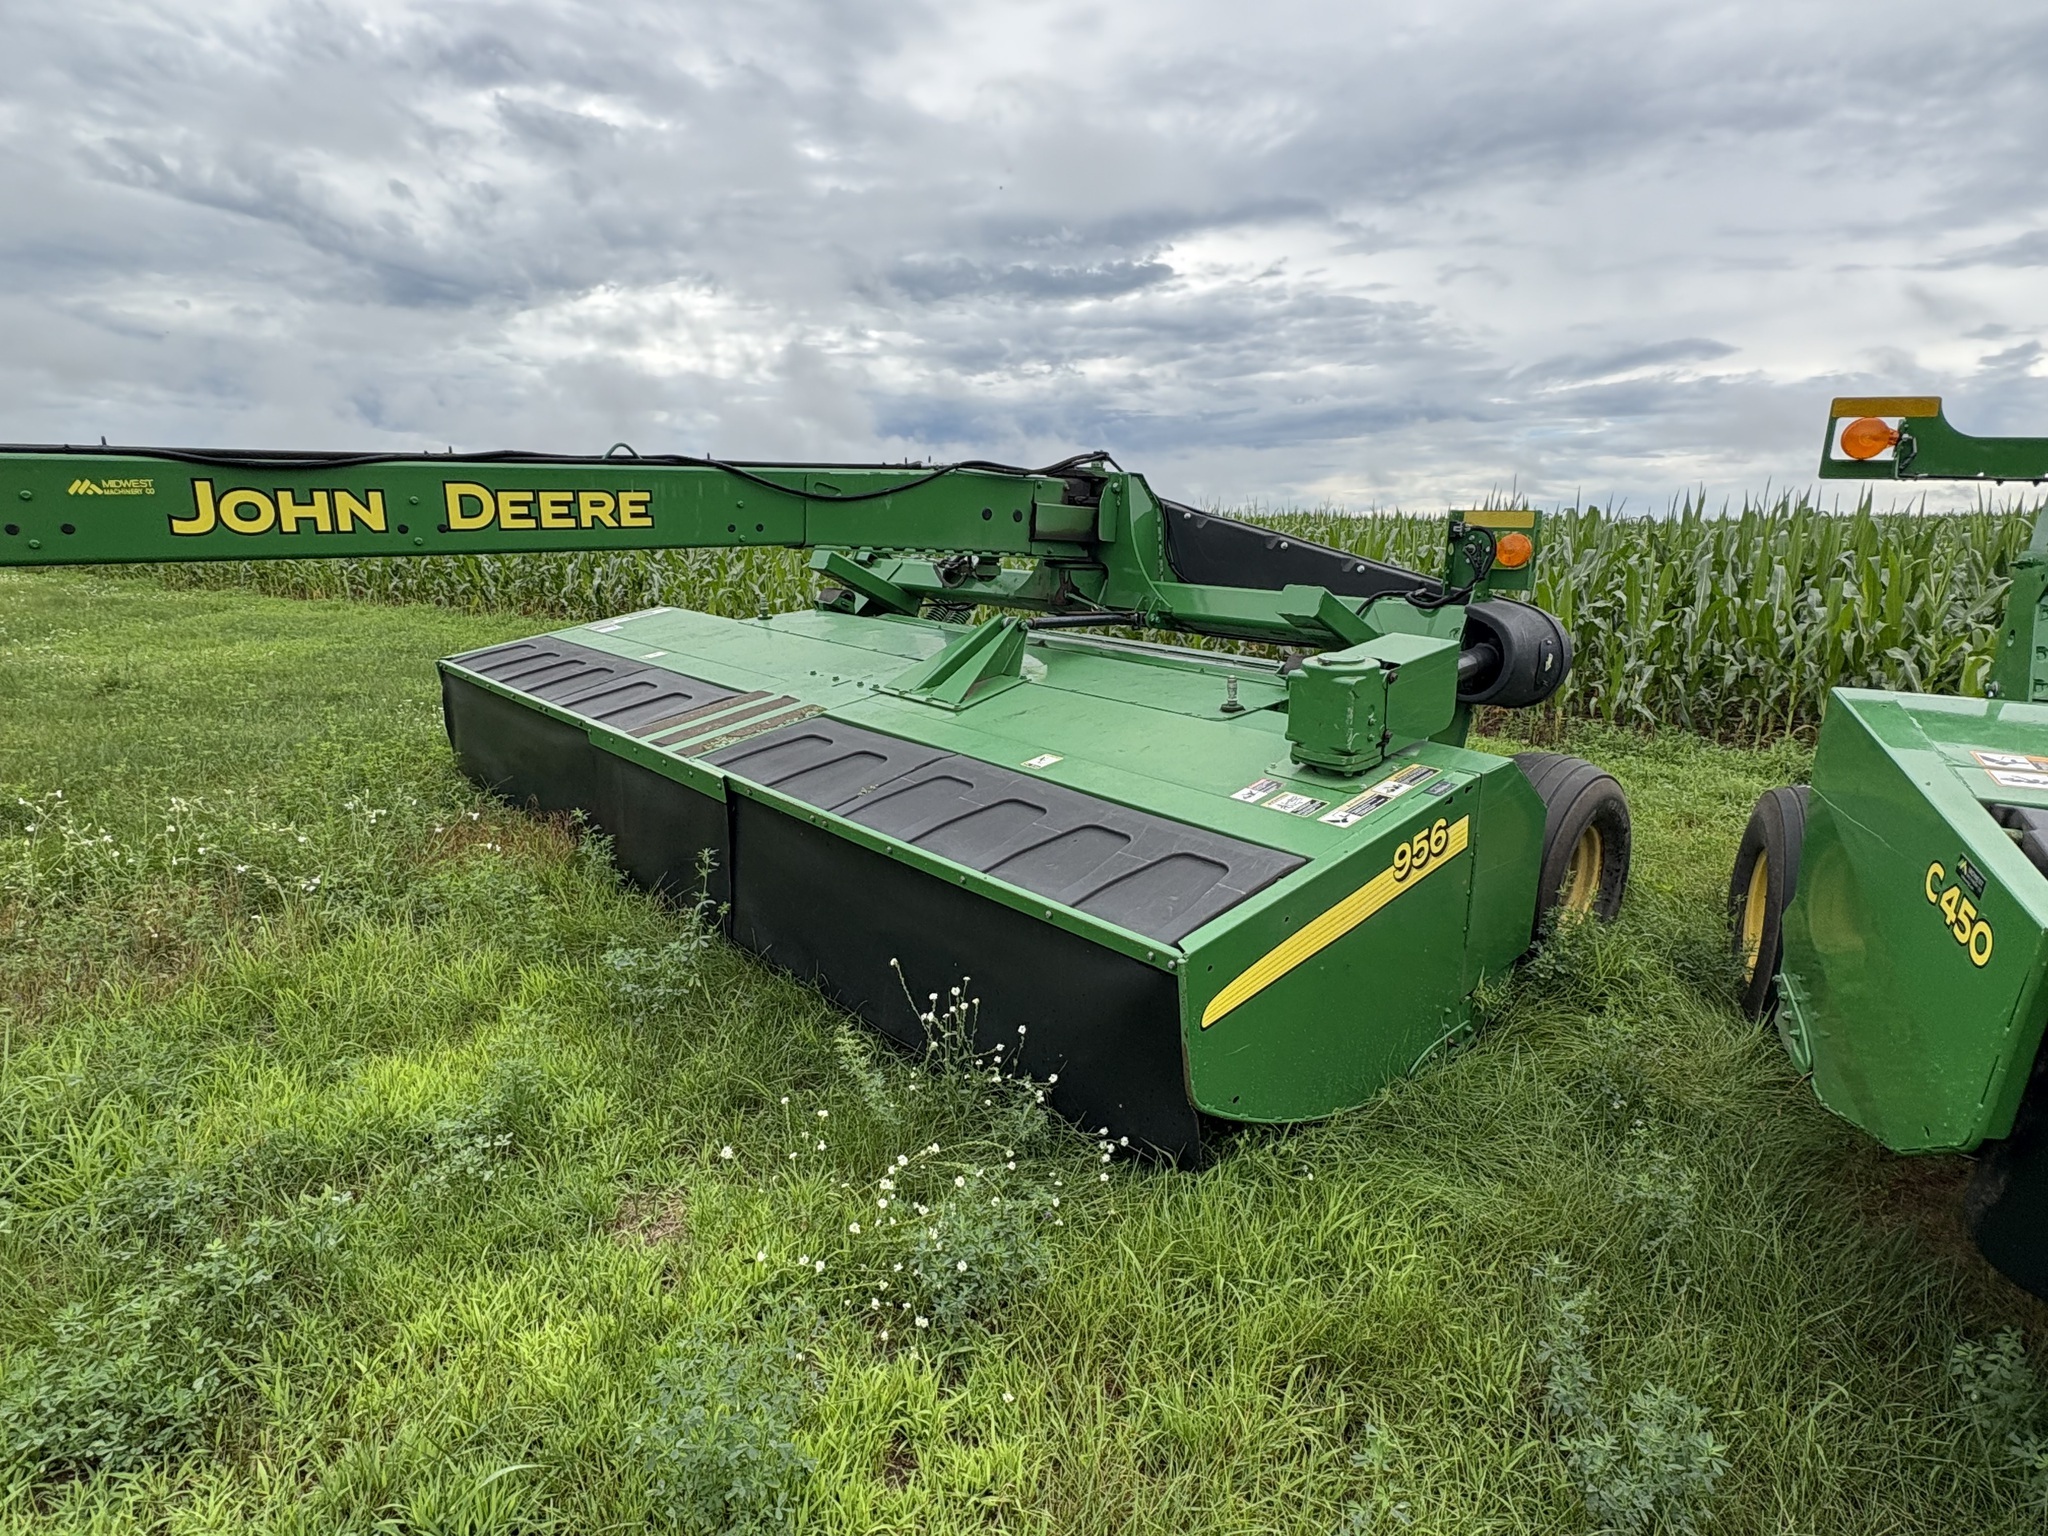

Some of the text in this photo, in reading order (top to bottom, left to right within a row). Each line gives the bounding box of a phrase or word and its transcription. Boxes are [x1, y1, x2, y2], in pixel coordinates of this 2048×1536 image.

[101, 479, 154, 488] MIDWEST
[168, 478, 655, 536] JOHN DEERE
[1392, 817, 1449, 882] 956
[1924, 860, 1994, 968] C450
